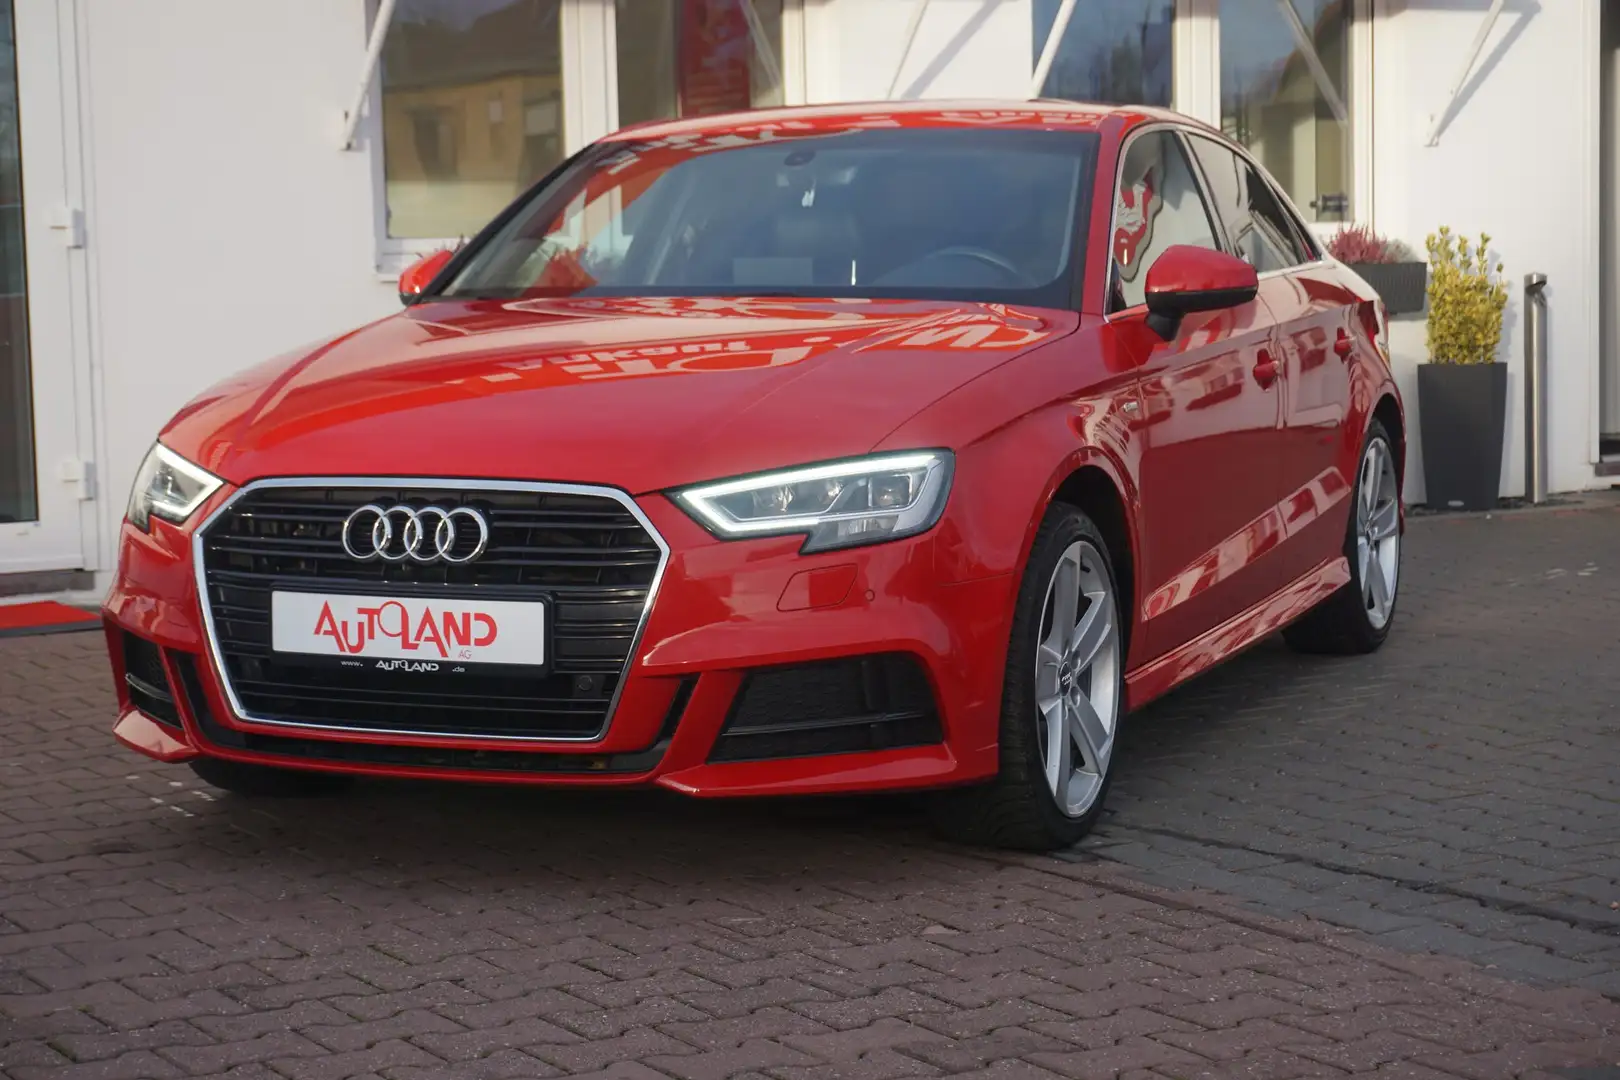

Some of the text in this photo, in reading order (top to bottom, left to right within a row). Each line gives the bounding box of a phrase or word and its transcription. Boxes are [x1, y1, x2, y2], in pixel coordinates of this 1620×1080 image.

[314, 600, 498, 658] AUTOLAND
[457, 649, 472, 660] AG
[376, 659, 439, 672] AUTOLAND
